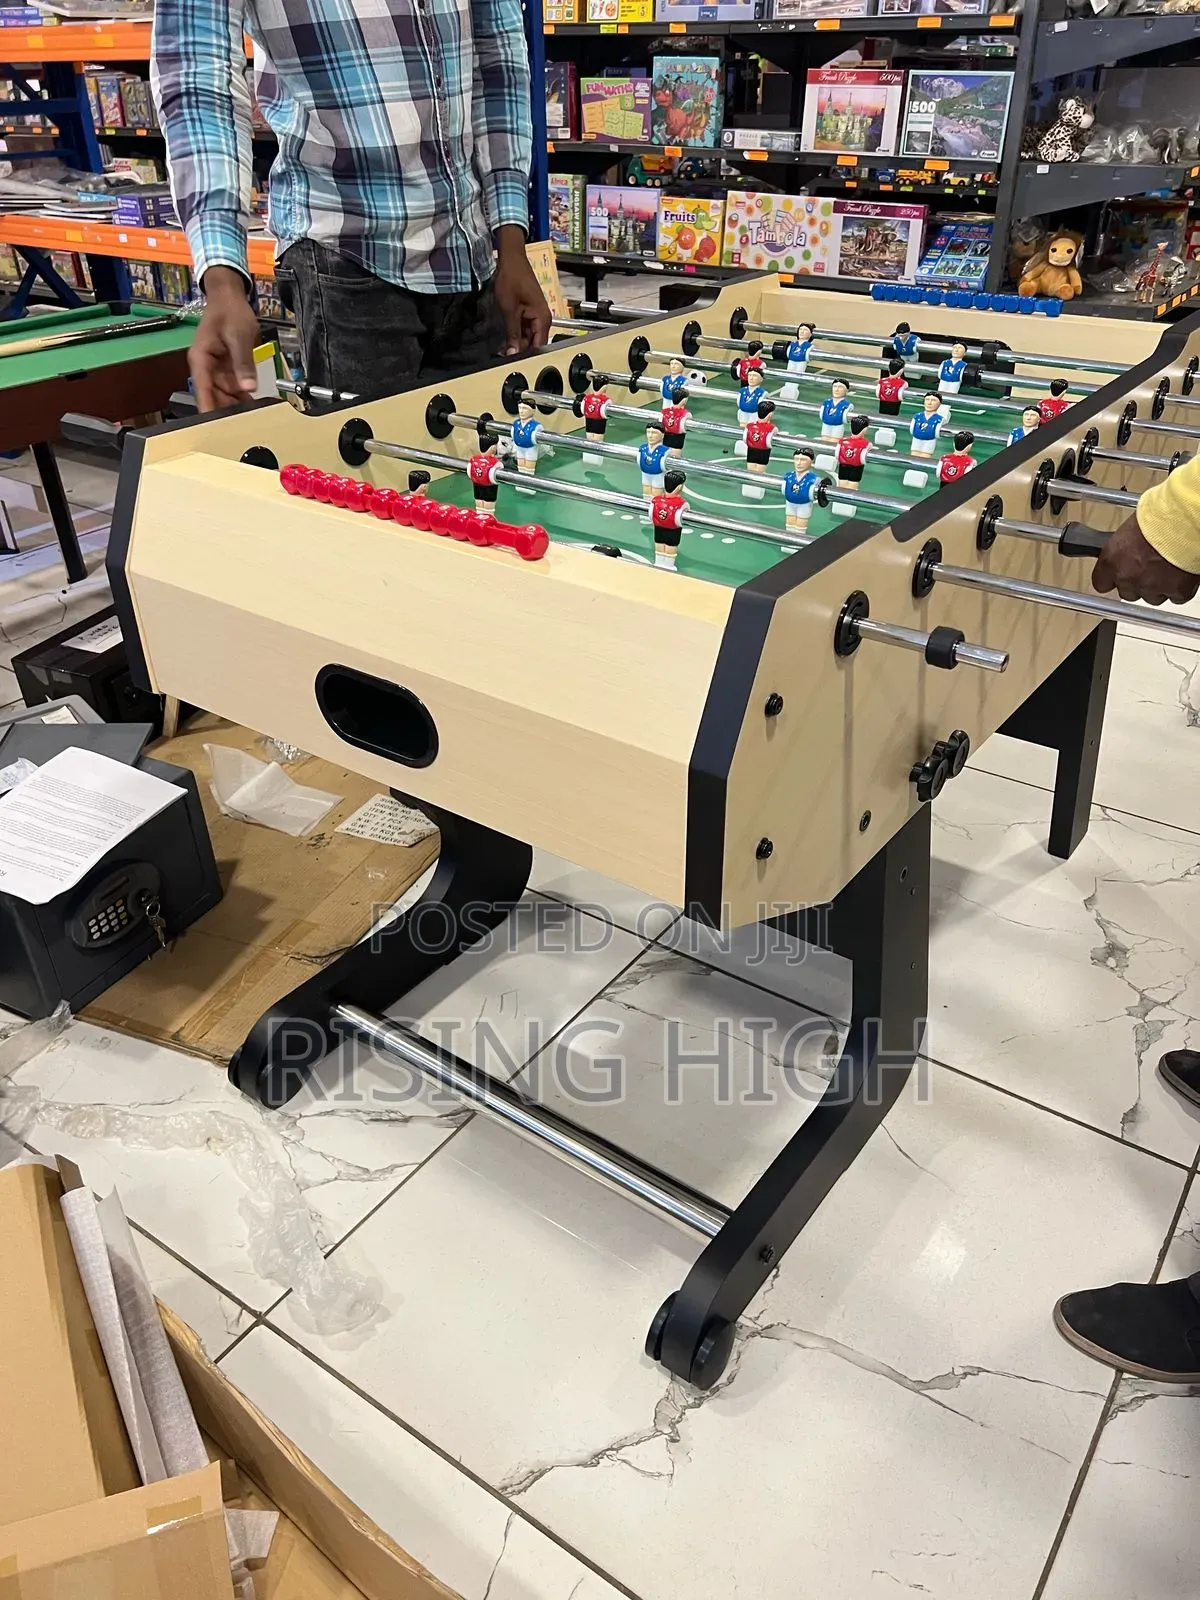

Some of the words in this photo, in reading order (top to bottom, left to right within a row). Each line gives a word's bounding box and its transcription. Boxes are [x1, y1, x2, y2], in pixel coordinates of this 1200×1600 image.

[590, 207, 609, 217] 500
[663, 210, 696, 223] Fruits
[748, 220, 807, 247] Tambola
[368, 807, 387, 816] ITEM
